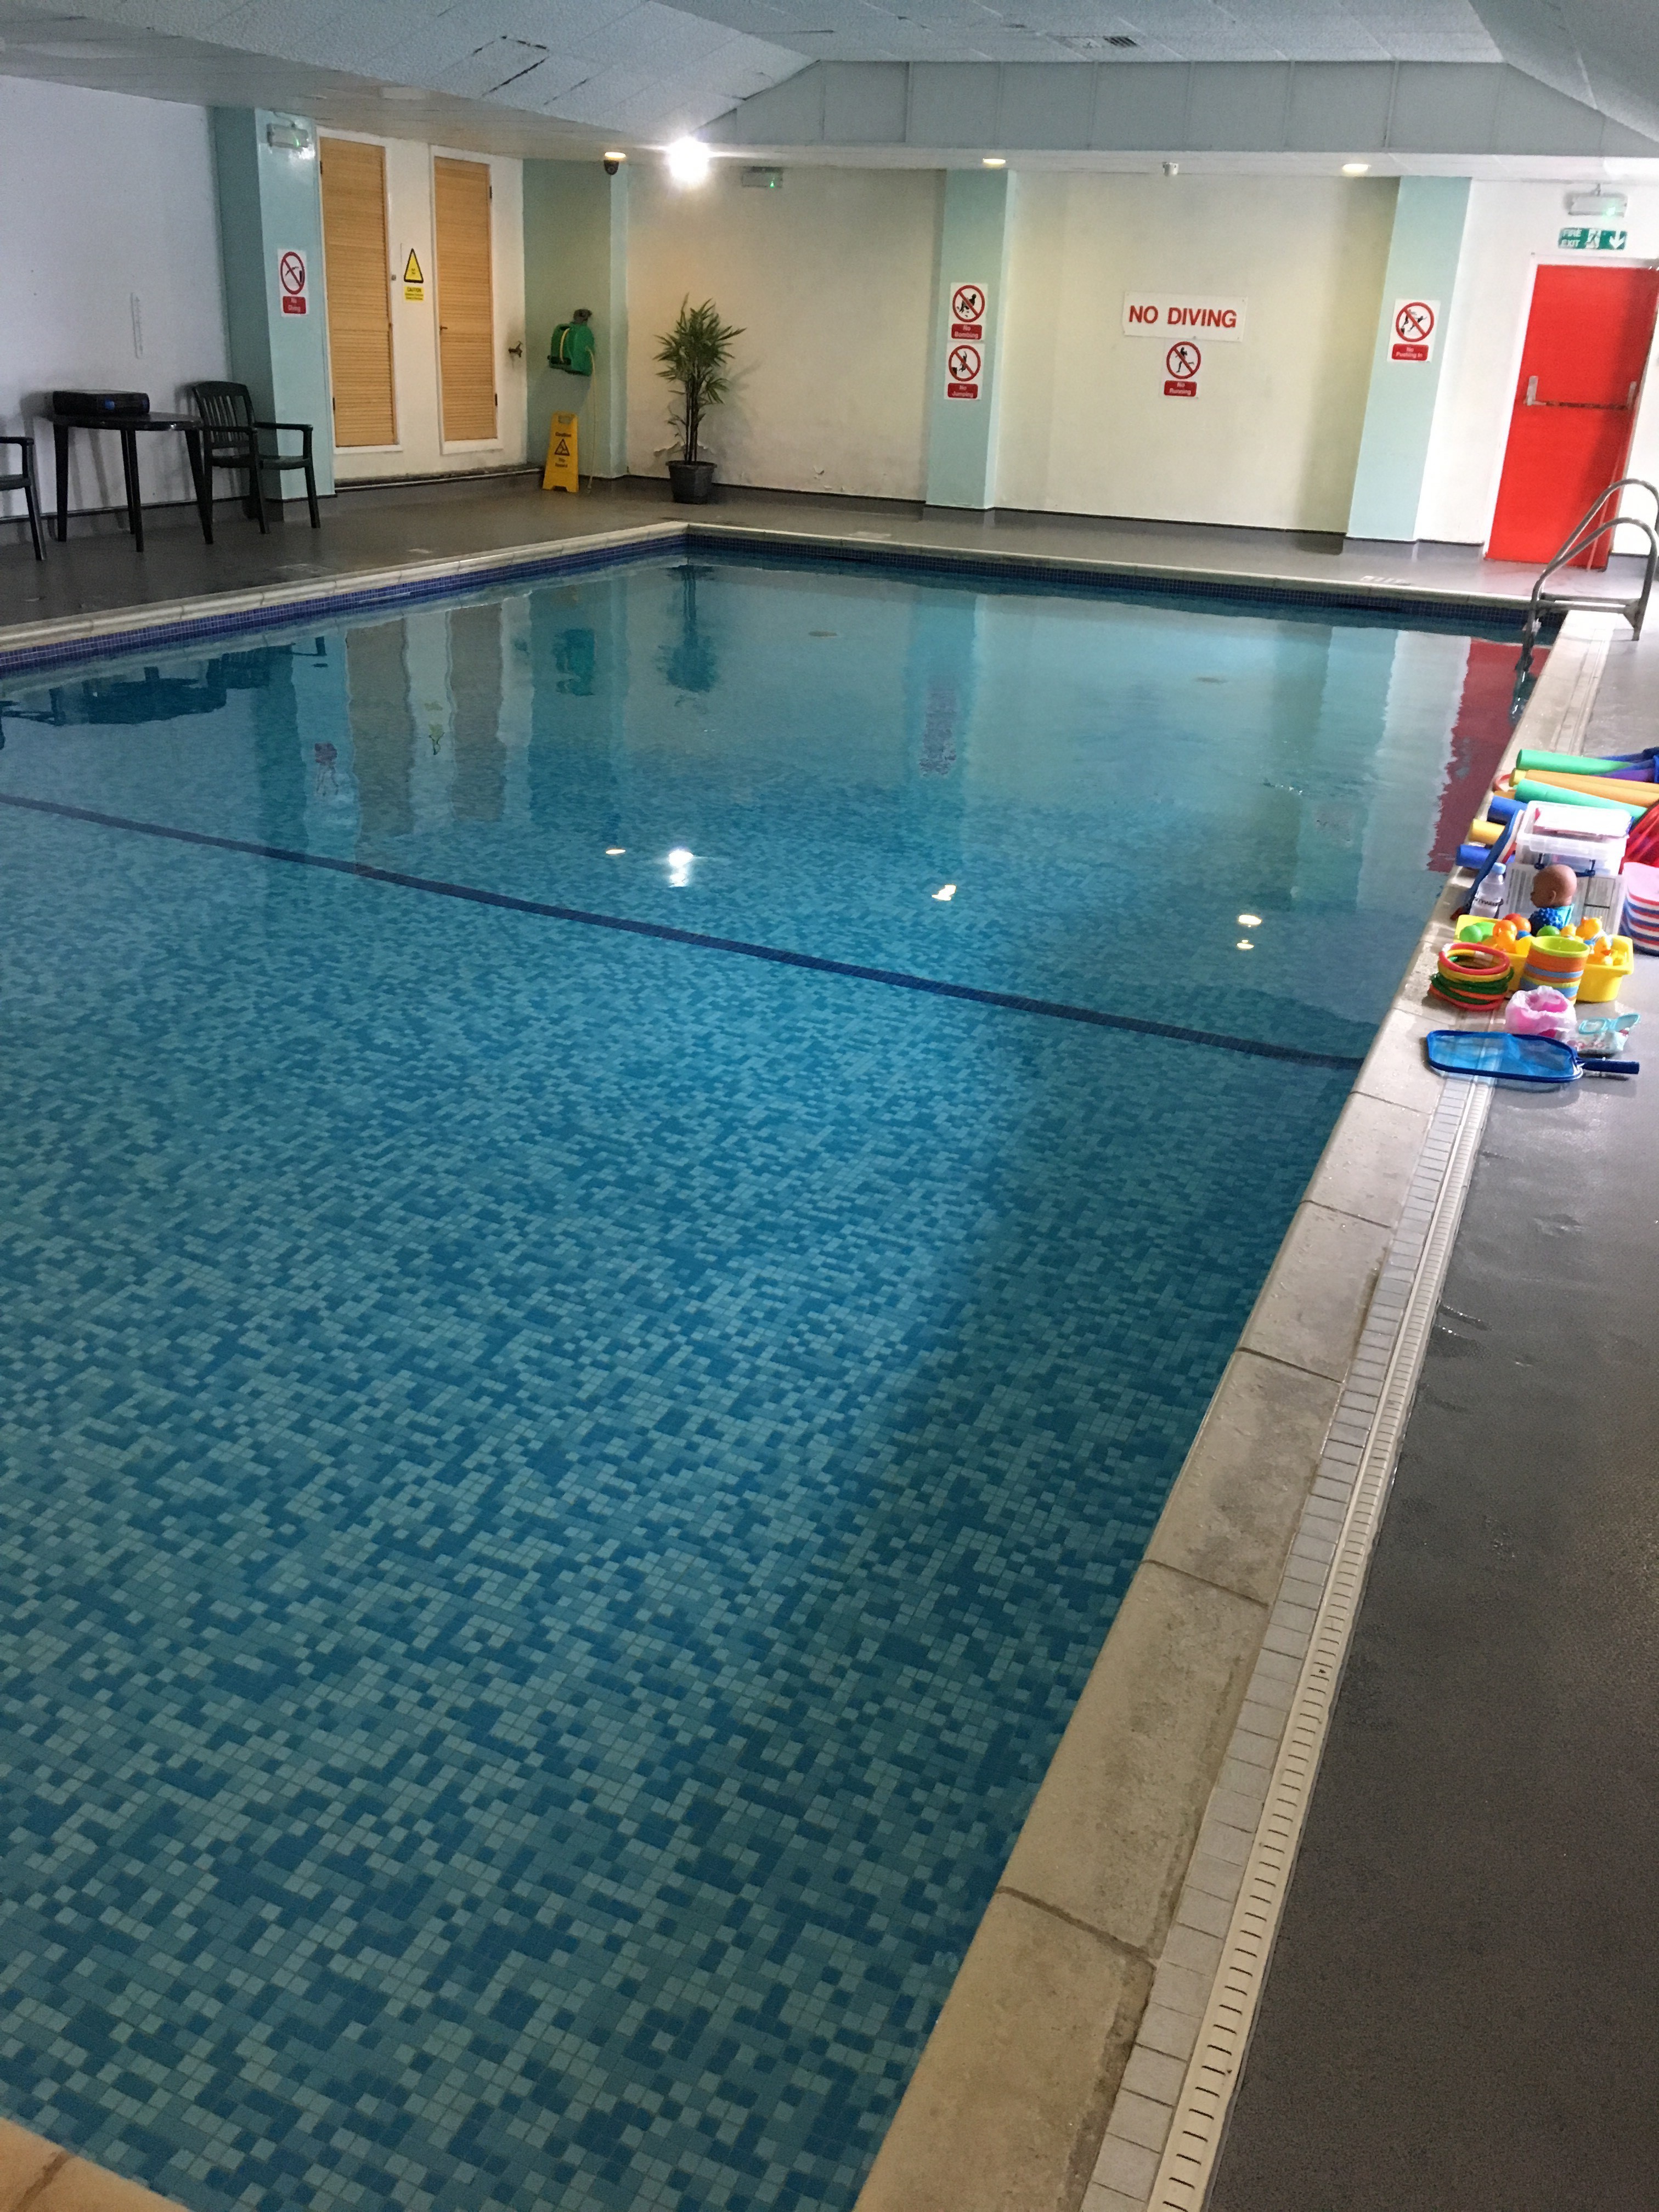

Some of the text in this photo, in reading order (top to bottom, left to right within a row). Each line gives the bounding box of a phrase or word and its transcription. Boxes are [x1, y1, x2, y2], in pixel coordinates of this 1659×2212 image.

[1129, 305, 1237, 328] NO DIVING
[955, 331, 979, 339] Bombing
[1169, 387, 1192, 396] Running
